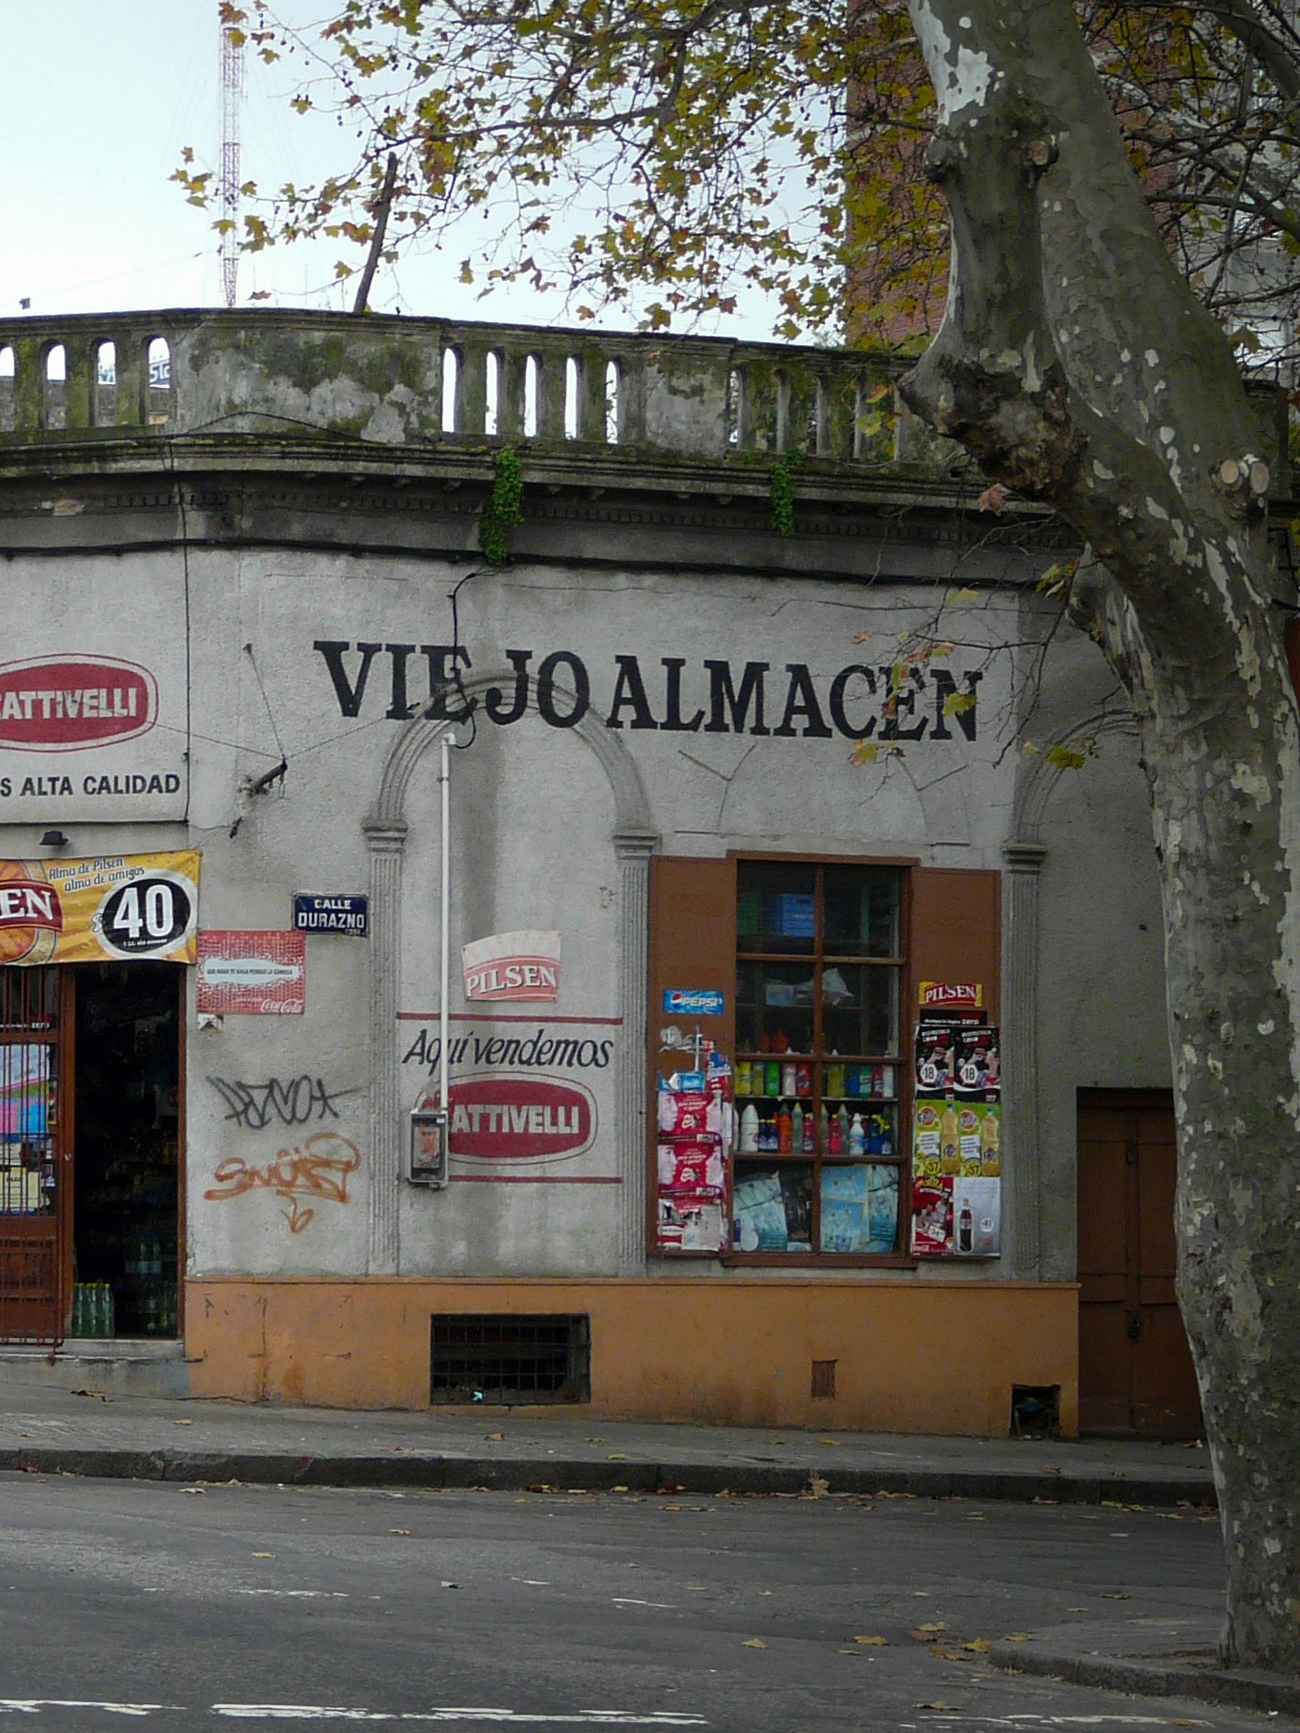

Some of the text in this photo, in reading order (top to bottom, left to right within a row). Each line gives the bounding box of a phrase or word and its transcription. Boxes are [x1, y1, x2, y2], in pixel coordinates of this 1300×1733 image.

[314, 641, 983, 742] VIEJO ALMACEN
[20, 776, 74, 797] ALTA
[83, 774, 181, 795] CALIDAD
[49, 856, 123, 880] Alma de Pilsen
[64, 867, 145, 892] alma de amigos
[113, 884, 174, 939] 40
[314, 899, 352, 910] CALLE
[298, 912, 365, 929] DURAZNO
[466, 965, 557, 998] PILSEN
[682, 997, 719, 1007] PEPSI
[926, 985, 976, 1003] PILSEN
[402, 1028, 614, 1077] Aquí vendemos
[923, 1066, 934, 1080] 18
[964, 1066, 975, 1081] 18
[451, 1104, 580, 1134] ATTIVELLI
